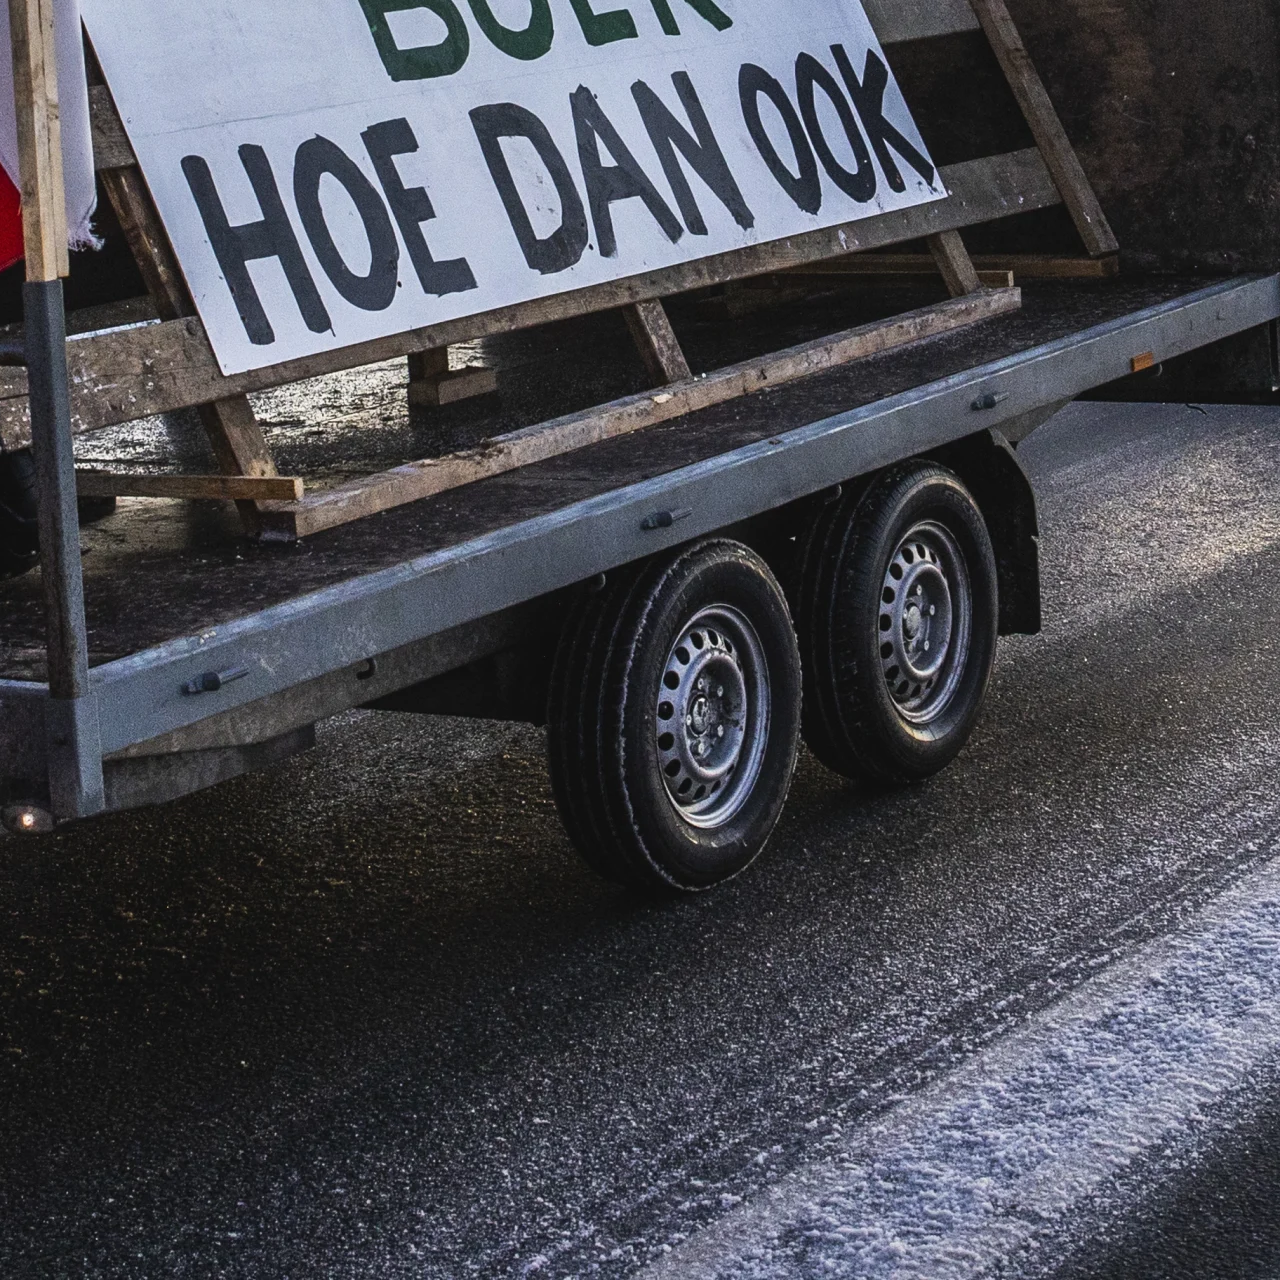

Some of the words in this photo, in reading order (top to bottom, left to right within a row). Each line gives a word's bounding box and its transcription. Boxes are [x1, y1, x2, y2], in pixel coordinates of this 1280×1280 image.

[180, 117, 477, 346] HOE
[469, 70, 756, 275] DAN
[738, 43, 935, 215] OOK
